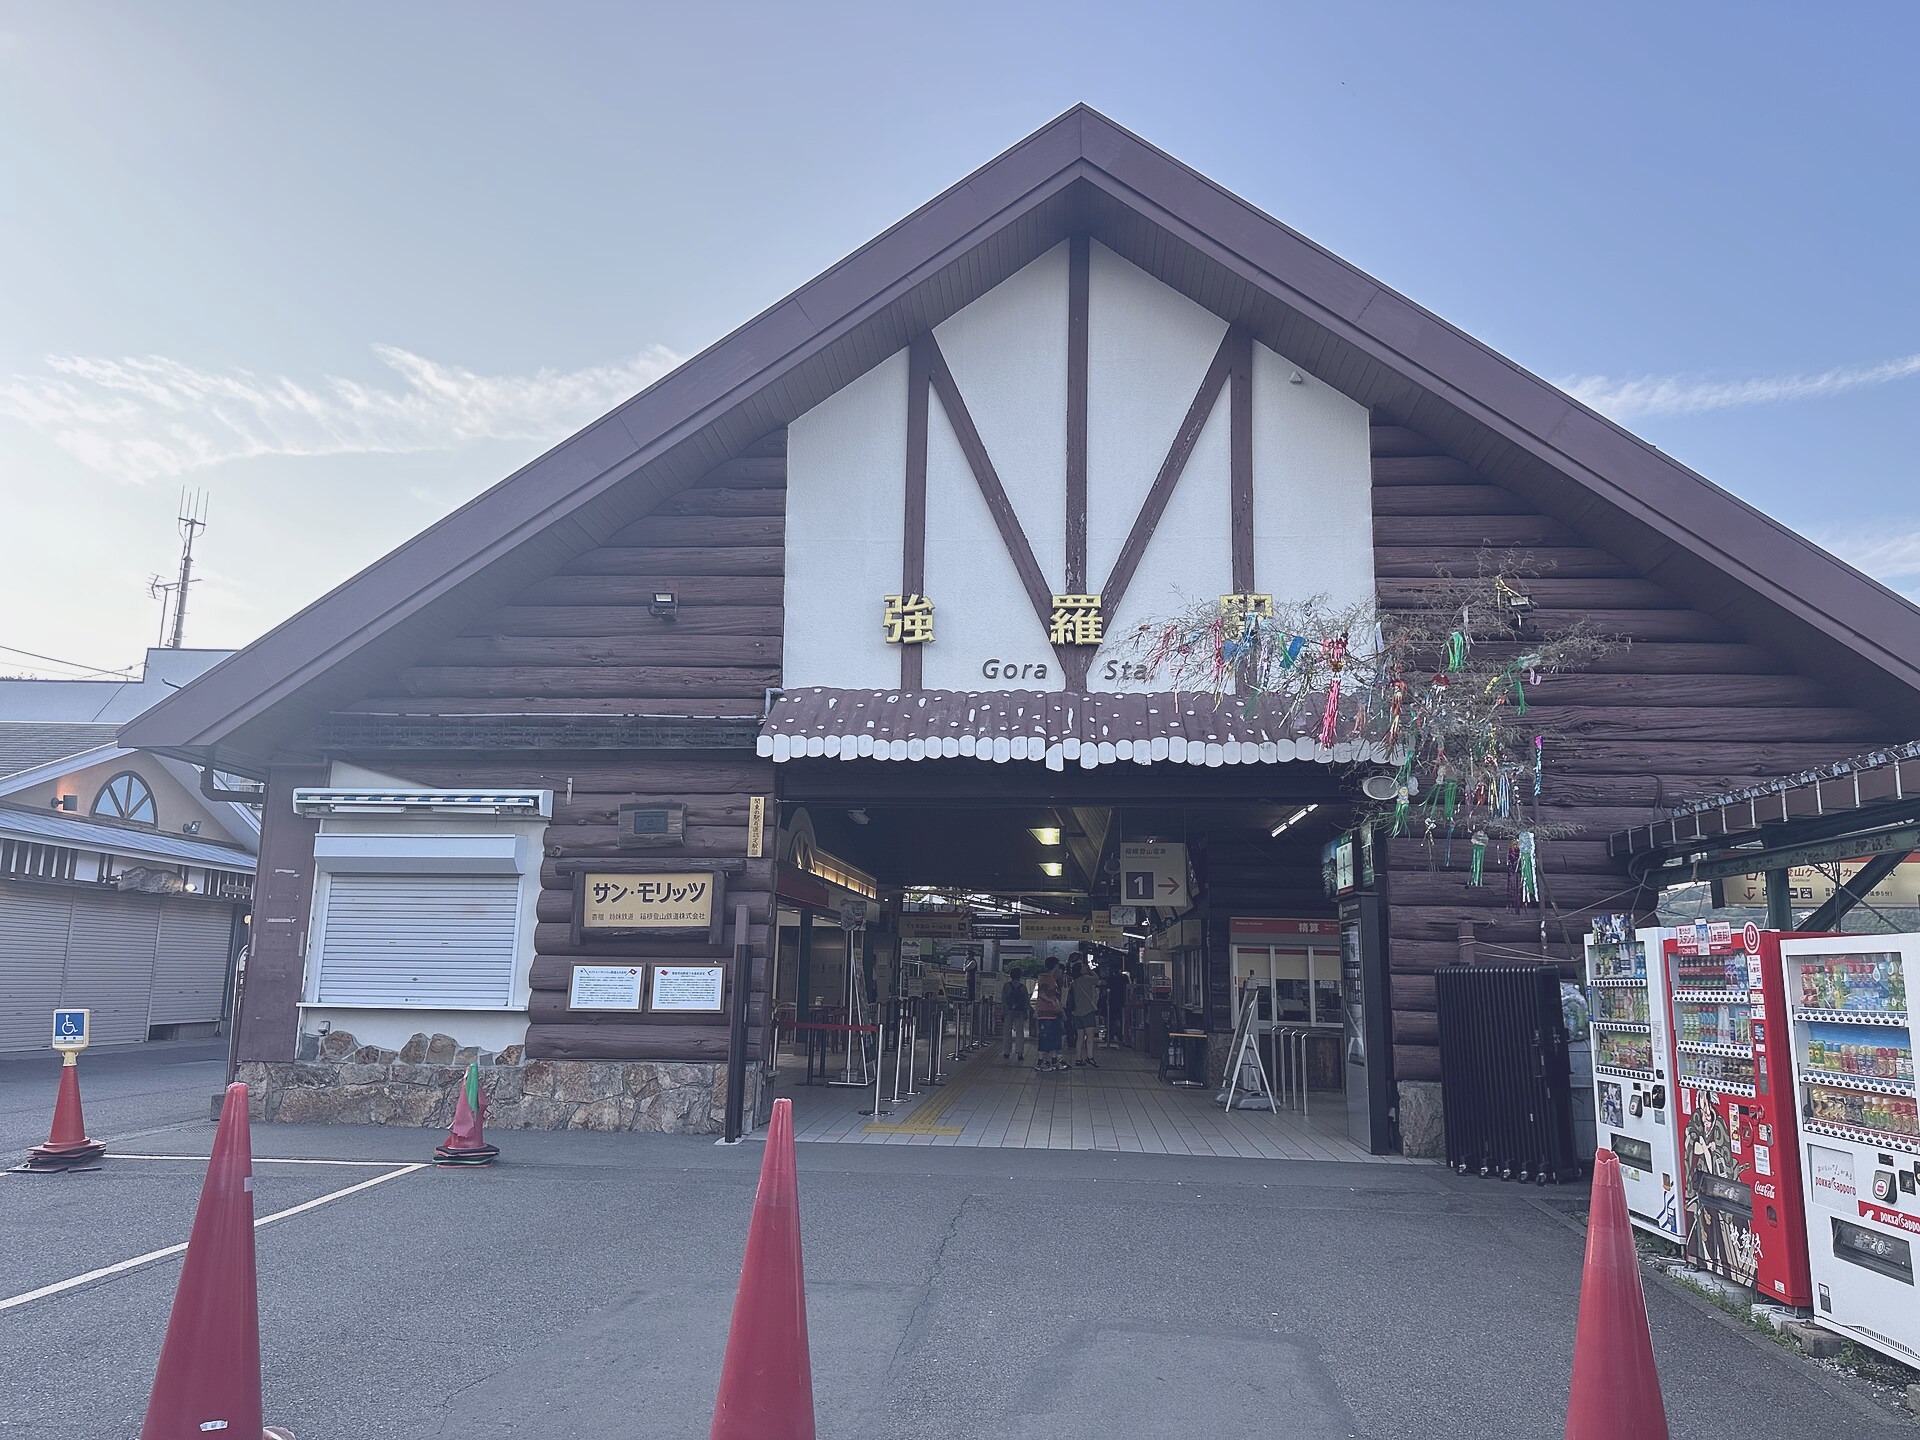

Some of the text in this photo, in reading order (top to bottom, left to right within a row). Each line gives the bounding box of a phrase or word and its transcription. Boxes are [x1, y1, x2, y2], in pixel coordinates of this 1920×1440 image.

[982, 658, 1047, 680] Gora
[593, 882, 706, 903] サン・モリッツ
[1134, 876, 1143, 895] 1
[640, 912, 706, 921] 箱根登山鉄道株式会社
[1298, 922, 1320, 933] 精算
